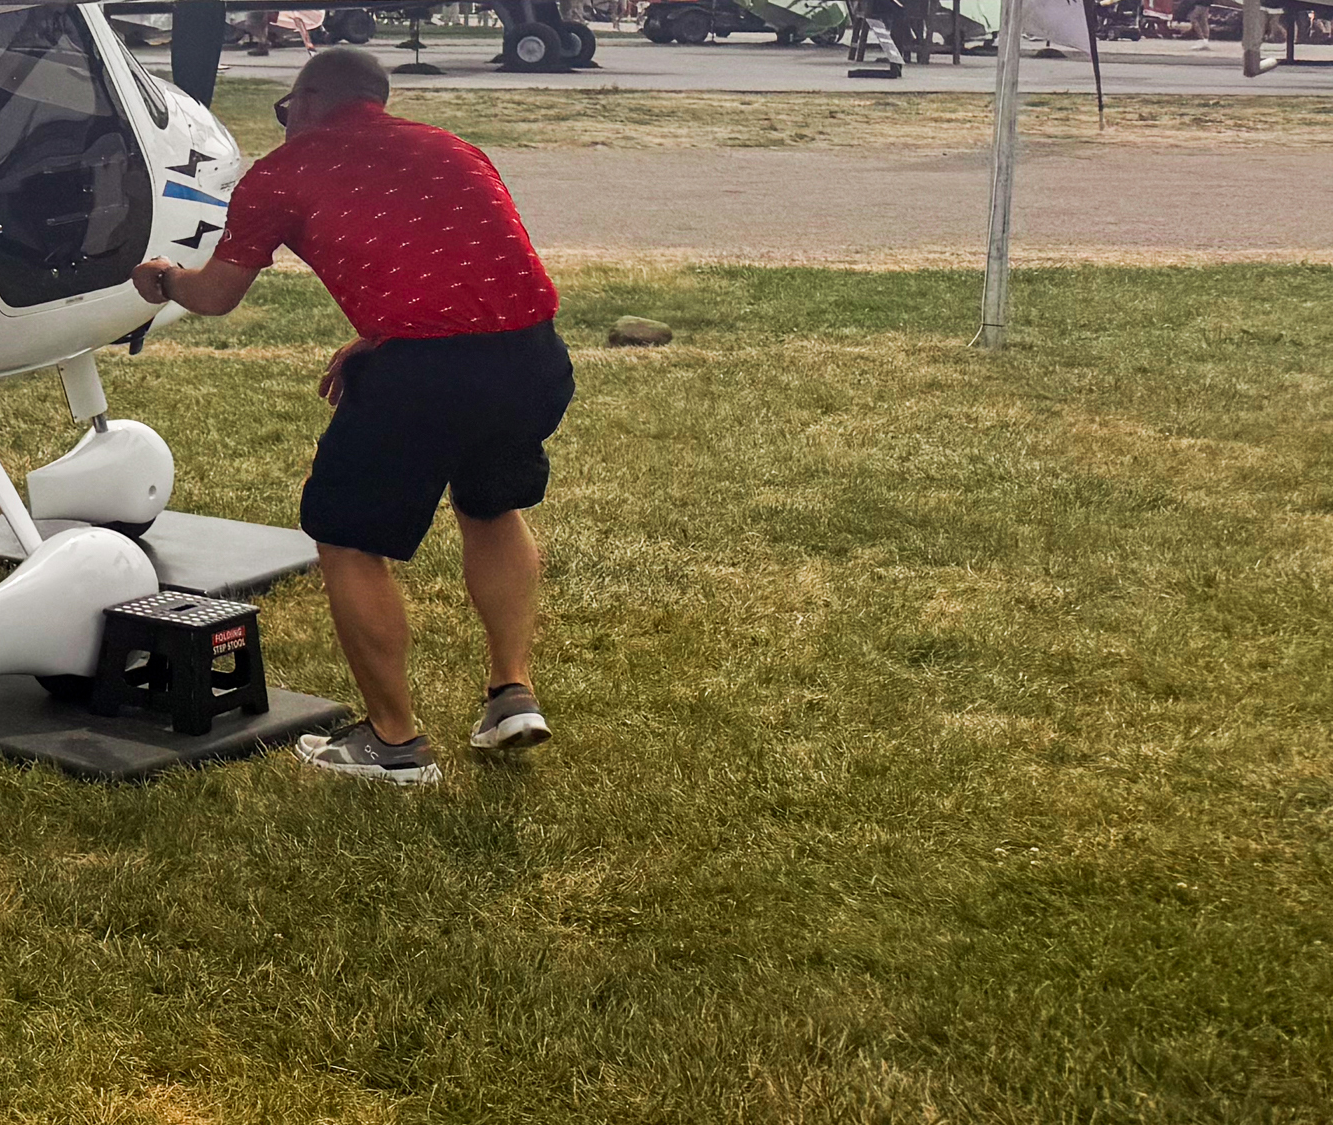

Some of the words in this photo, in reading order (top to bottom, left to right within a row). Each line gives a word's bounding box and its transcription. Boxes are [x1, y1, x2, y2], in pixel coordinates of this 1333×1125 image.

[215, 627, 243, 644] FOLDING
[213, 643, 227, 655] STEP
[227, 638, 246, 651] STOOL
